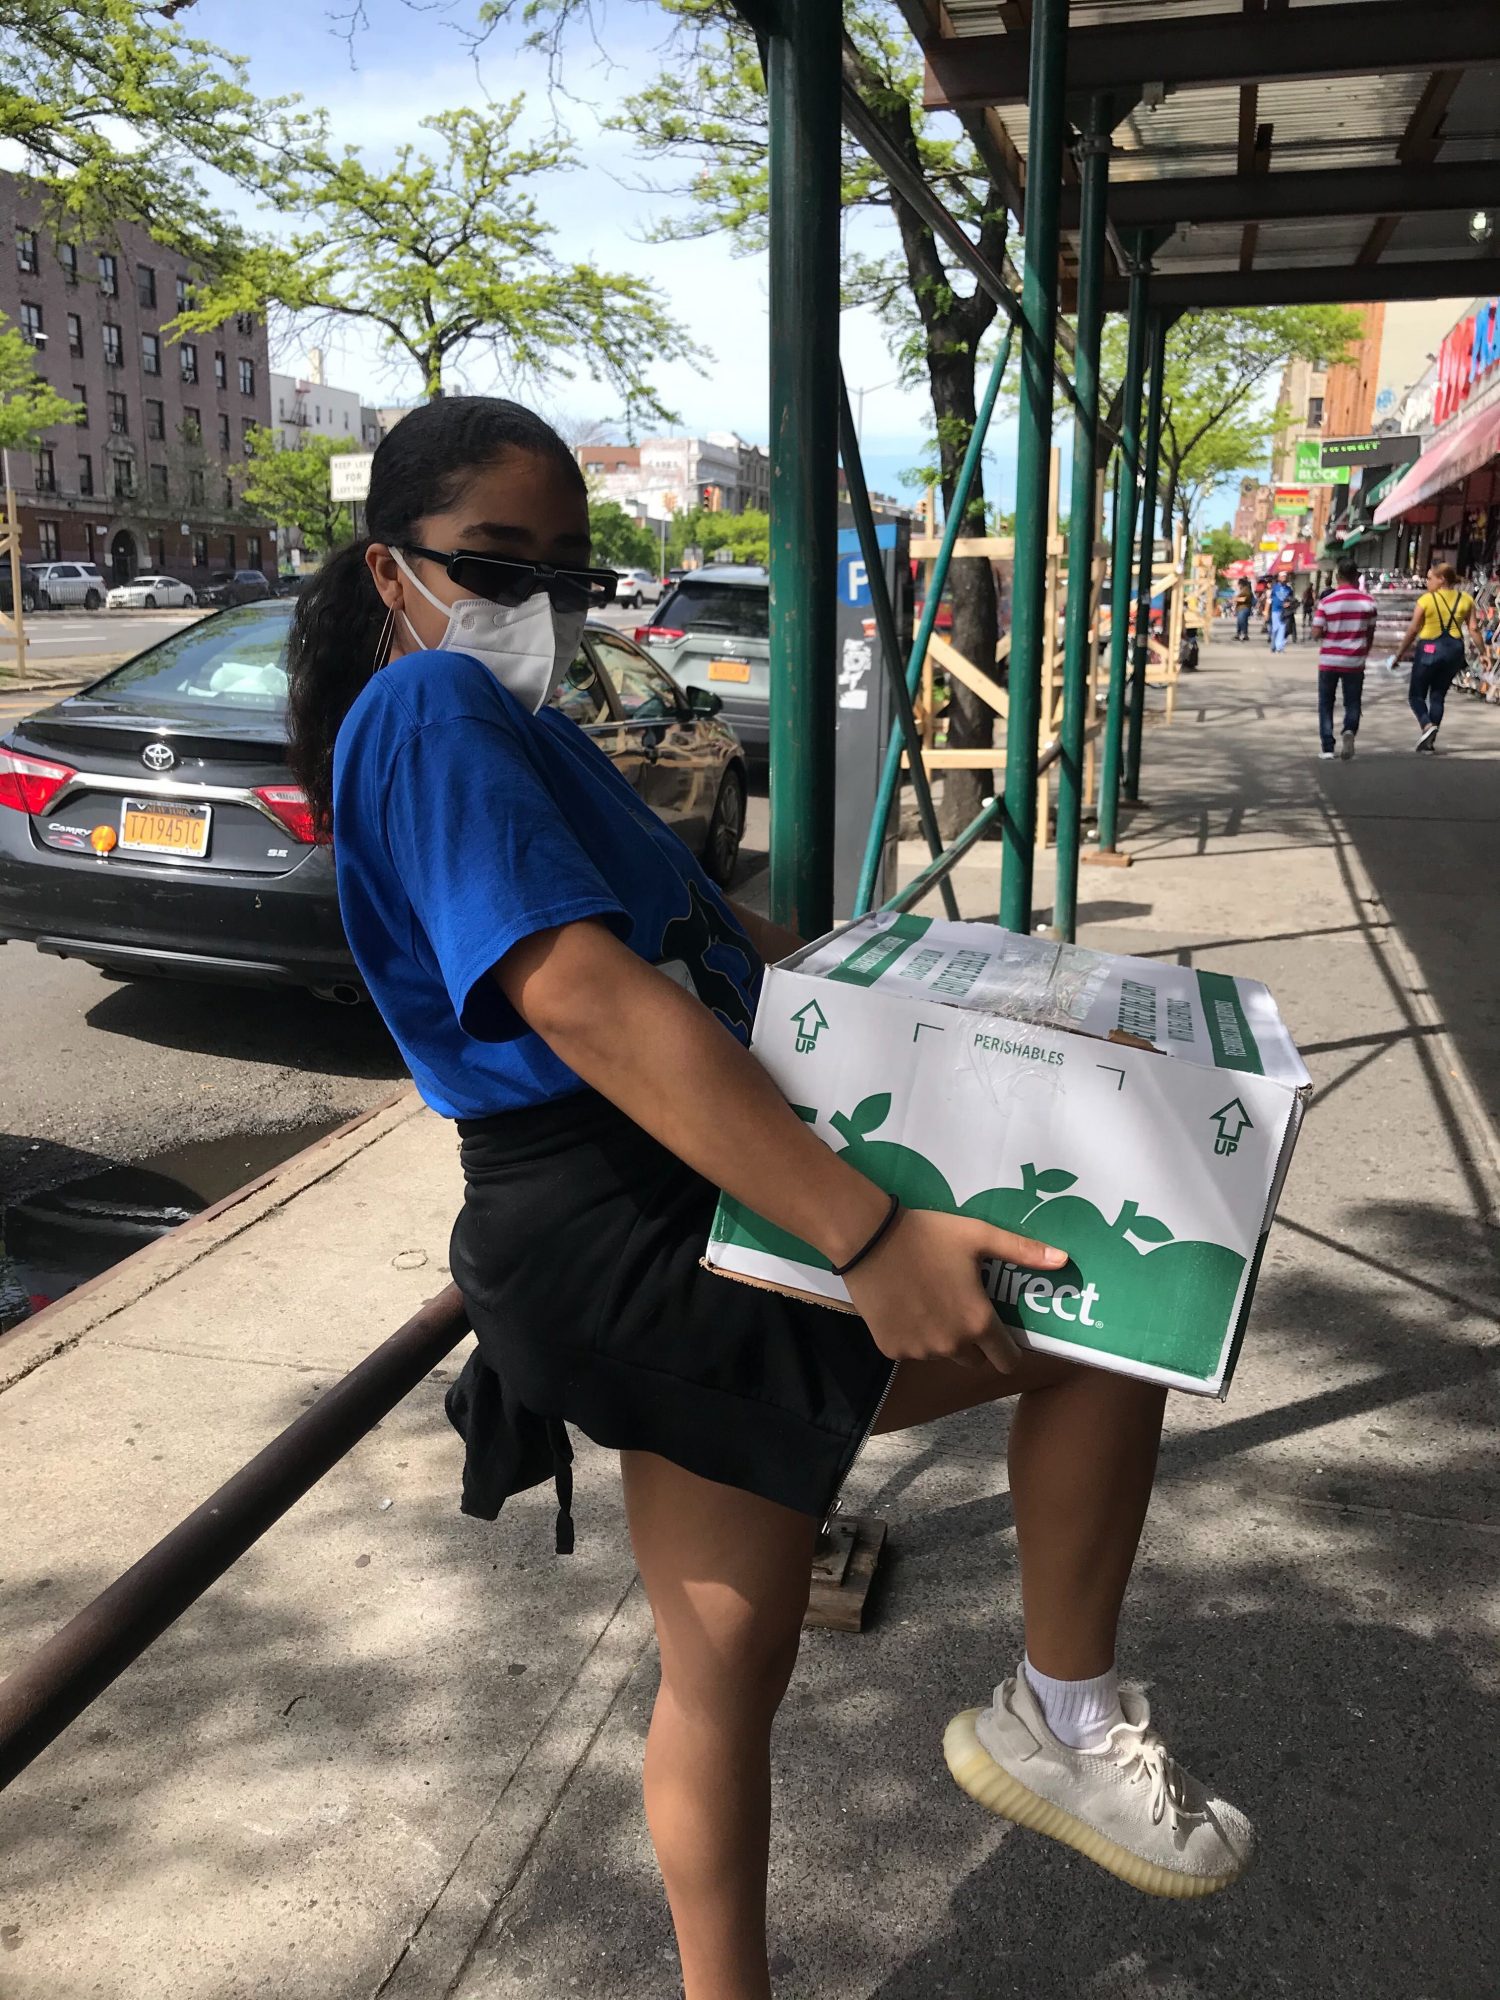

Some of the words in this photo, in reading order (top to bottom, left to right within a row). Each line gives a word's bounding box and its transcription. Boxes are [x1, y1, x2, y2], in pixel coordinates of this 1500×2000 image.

[345, 472, 363, 482] FOR
[1299, 468, 1339, 480] BLOCK
[48, 823, 93, 837] CAMRY
[267, 848, 289, 858] SE
[795, 1037, 816, 1055] UP
[973, 1033, 1065, 1066] PERISHABLES
[1213, 1138, 1238, 1157] UP
